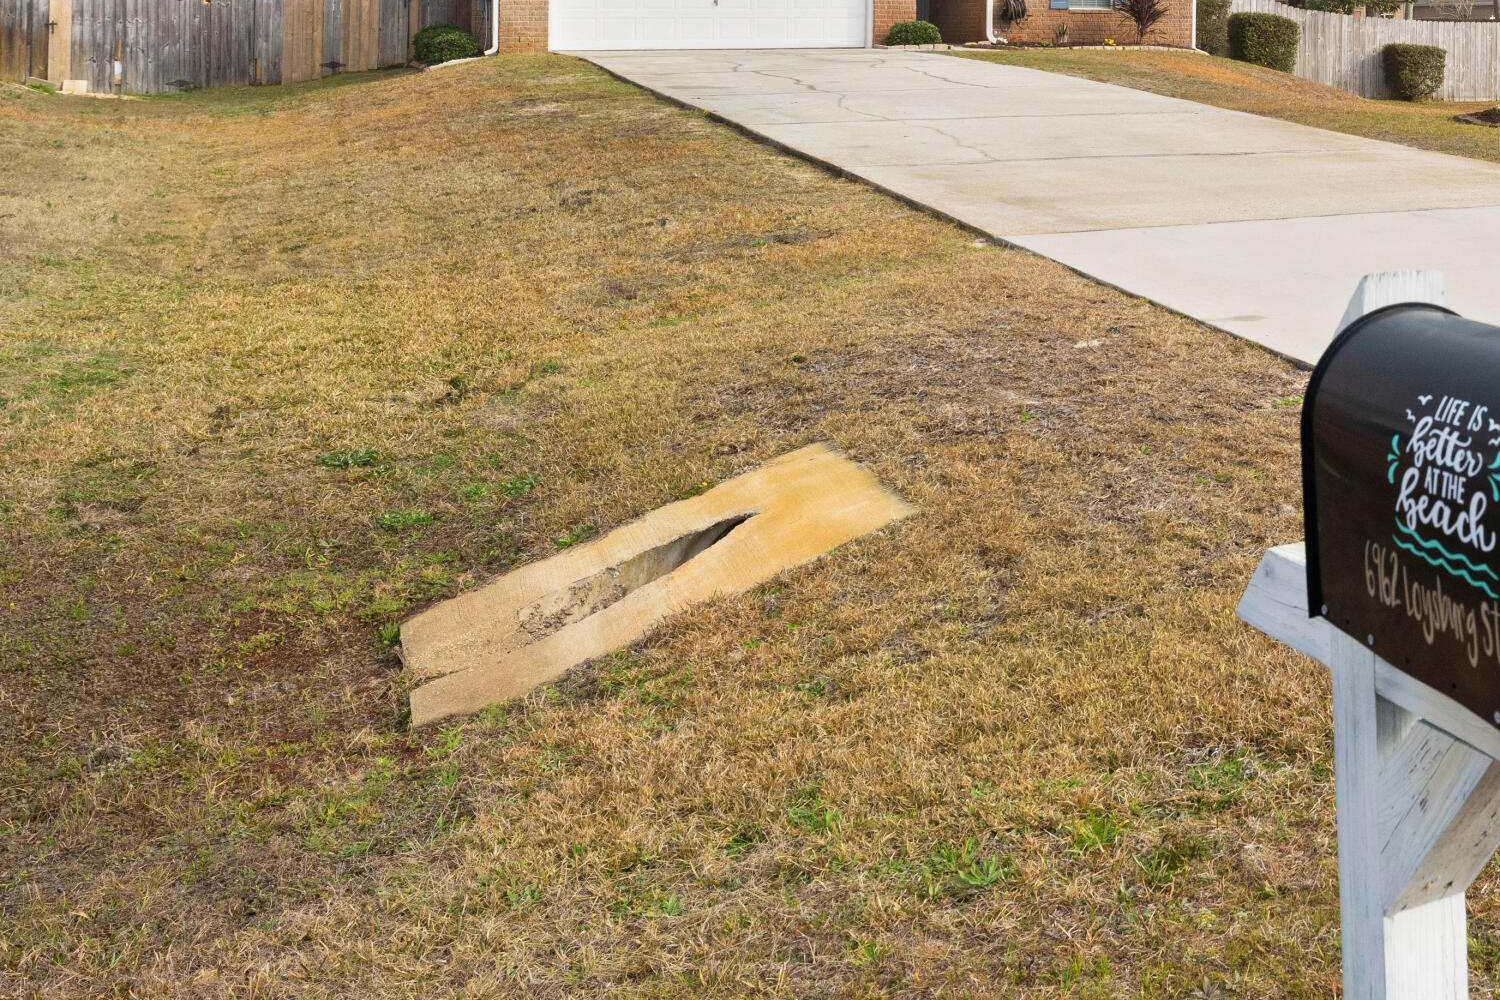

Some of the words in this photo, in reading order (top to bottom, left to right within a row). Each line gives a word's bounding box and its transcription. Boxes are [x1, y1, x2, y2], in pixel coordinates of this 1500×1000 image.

[1434, 395, 1470, 426] LIFE
[1467, 404, 1488, 432] IS
[1406, 416, 1483, 477] better
[1395, 467, 1496, 552] beach
[1424, 466, 1441, 495] AT
[1441, 471, 1467, 505] THE
[1365, 540, 1402, 608] 6962
[1402, 565, 1479, 669] Loysburg
